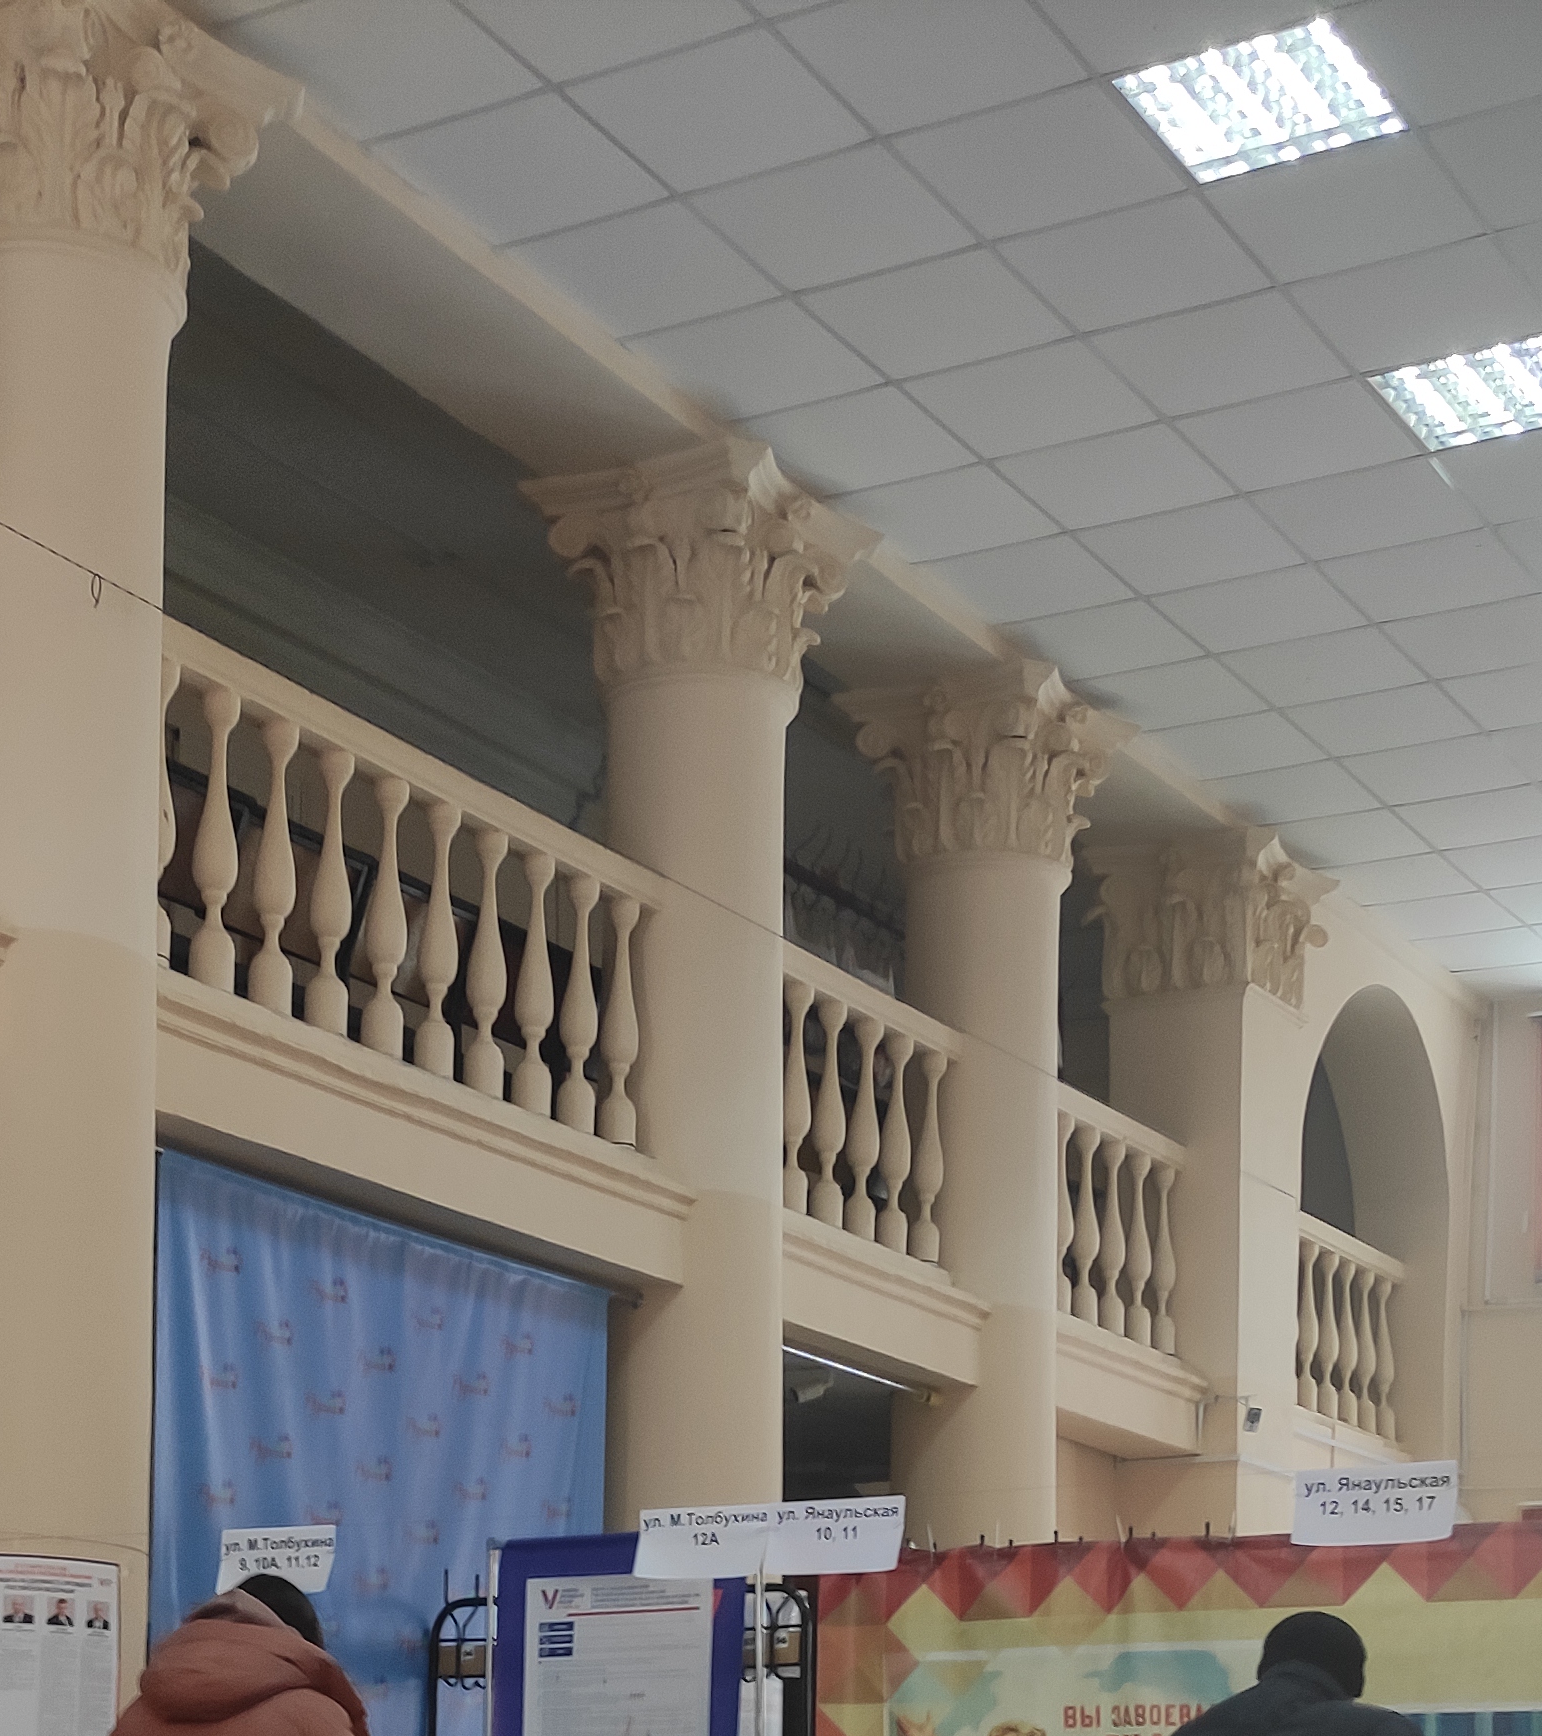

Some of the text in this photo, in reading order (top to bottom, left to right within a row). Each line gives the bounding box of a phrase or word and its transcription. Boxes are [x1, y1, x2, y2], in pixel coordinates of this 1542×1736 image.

[1304, 1475, 1451, 1497] ул. Янаульская
[777, 1505, 899, 1525] ул. Янаульская
[1320, 1496, 1436, 1517] 12, 14, 15, 17
[643, 1510, 768, 1531] ул. М.Толбухина
[842, 1525, 858, 1540] 11
[1063, 1704, 1101, 1728] ВЫ
